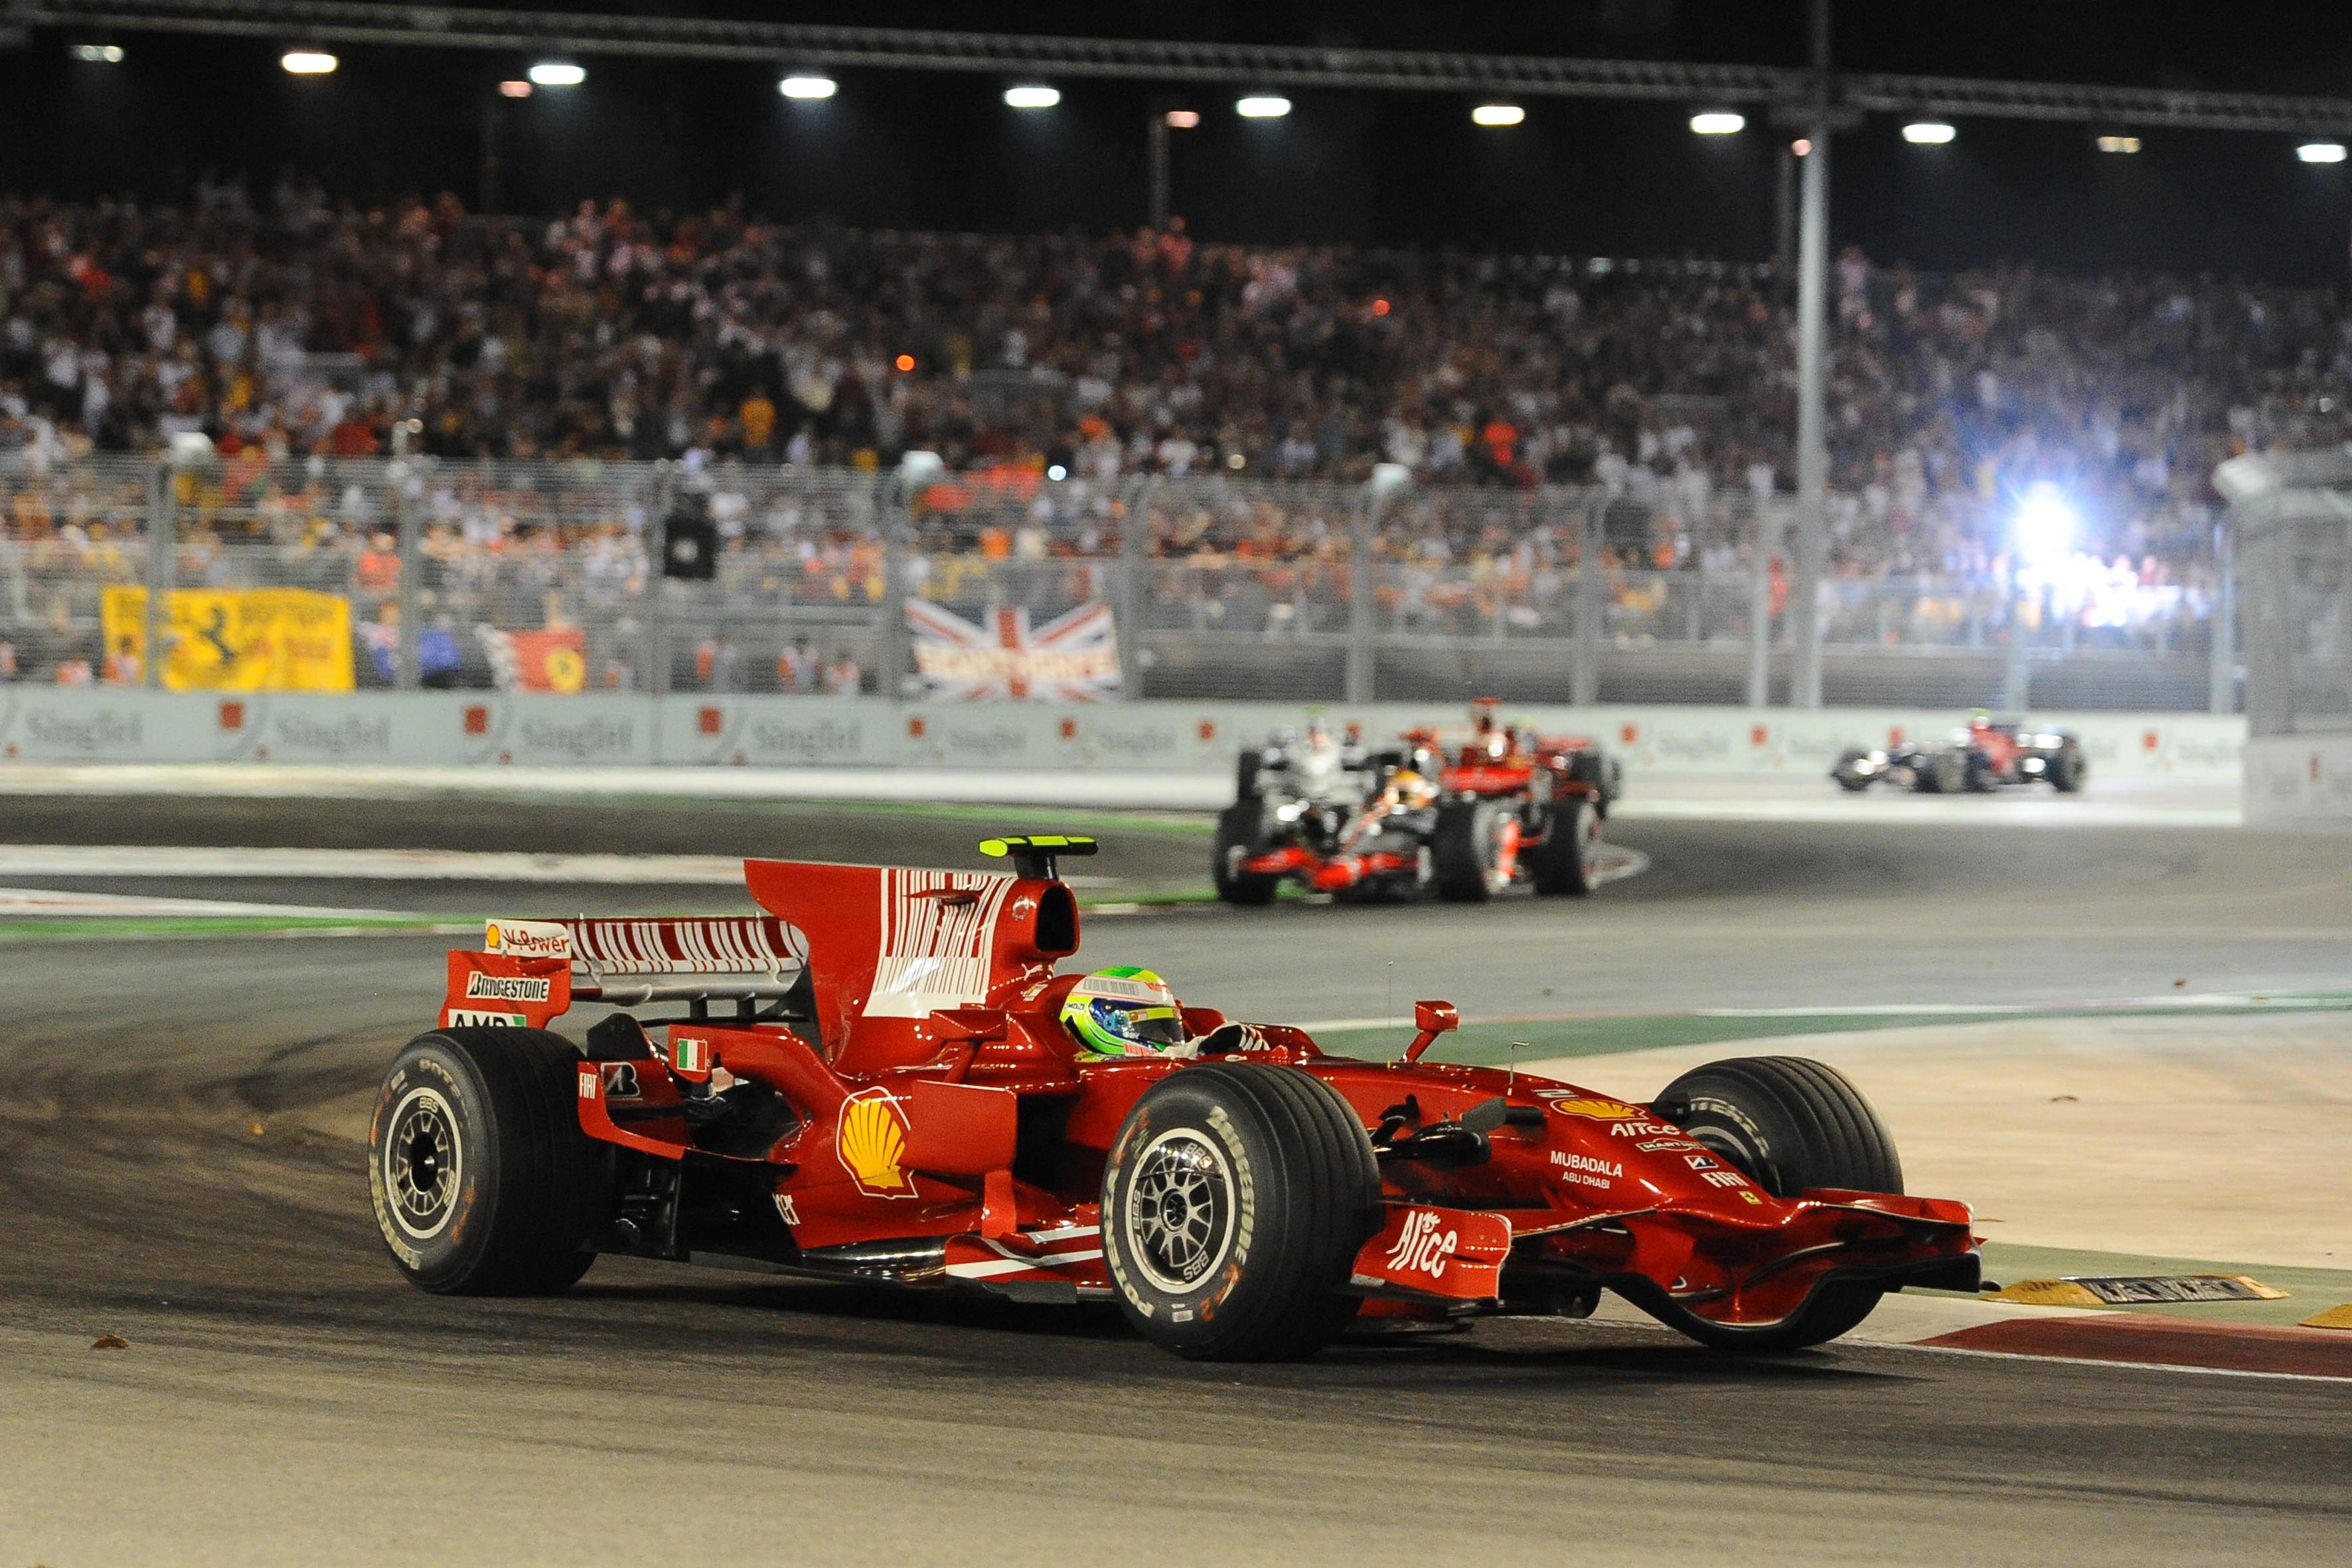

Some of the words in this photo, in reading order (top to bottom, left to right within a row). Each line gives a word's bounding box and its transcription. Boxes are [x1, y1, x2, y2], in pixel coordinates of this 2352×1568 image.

[504, 929, 570, 953] V-Power
[469, 973, 548, 998] BRIDGESTONE
[580, 1072, 597, 1099] FIAT
[419, 1097, 439, 1114] BBS
[1551, 1150, 1623, 1178] MUBADALA
[1562, 1171, 1582, 1184] ABU
[1583, 1174, 1610, 1190] DHABI
[1700, 1171, 1750, 1188] FIAT
[771, 1193, 801, 1226] cer
[1133, 1189, 1141, 1229] BBS
[1385, 1210, 1458, 1279] Alice
[1184, 1250, 1210, 1281] BBS
